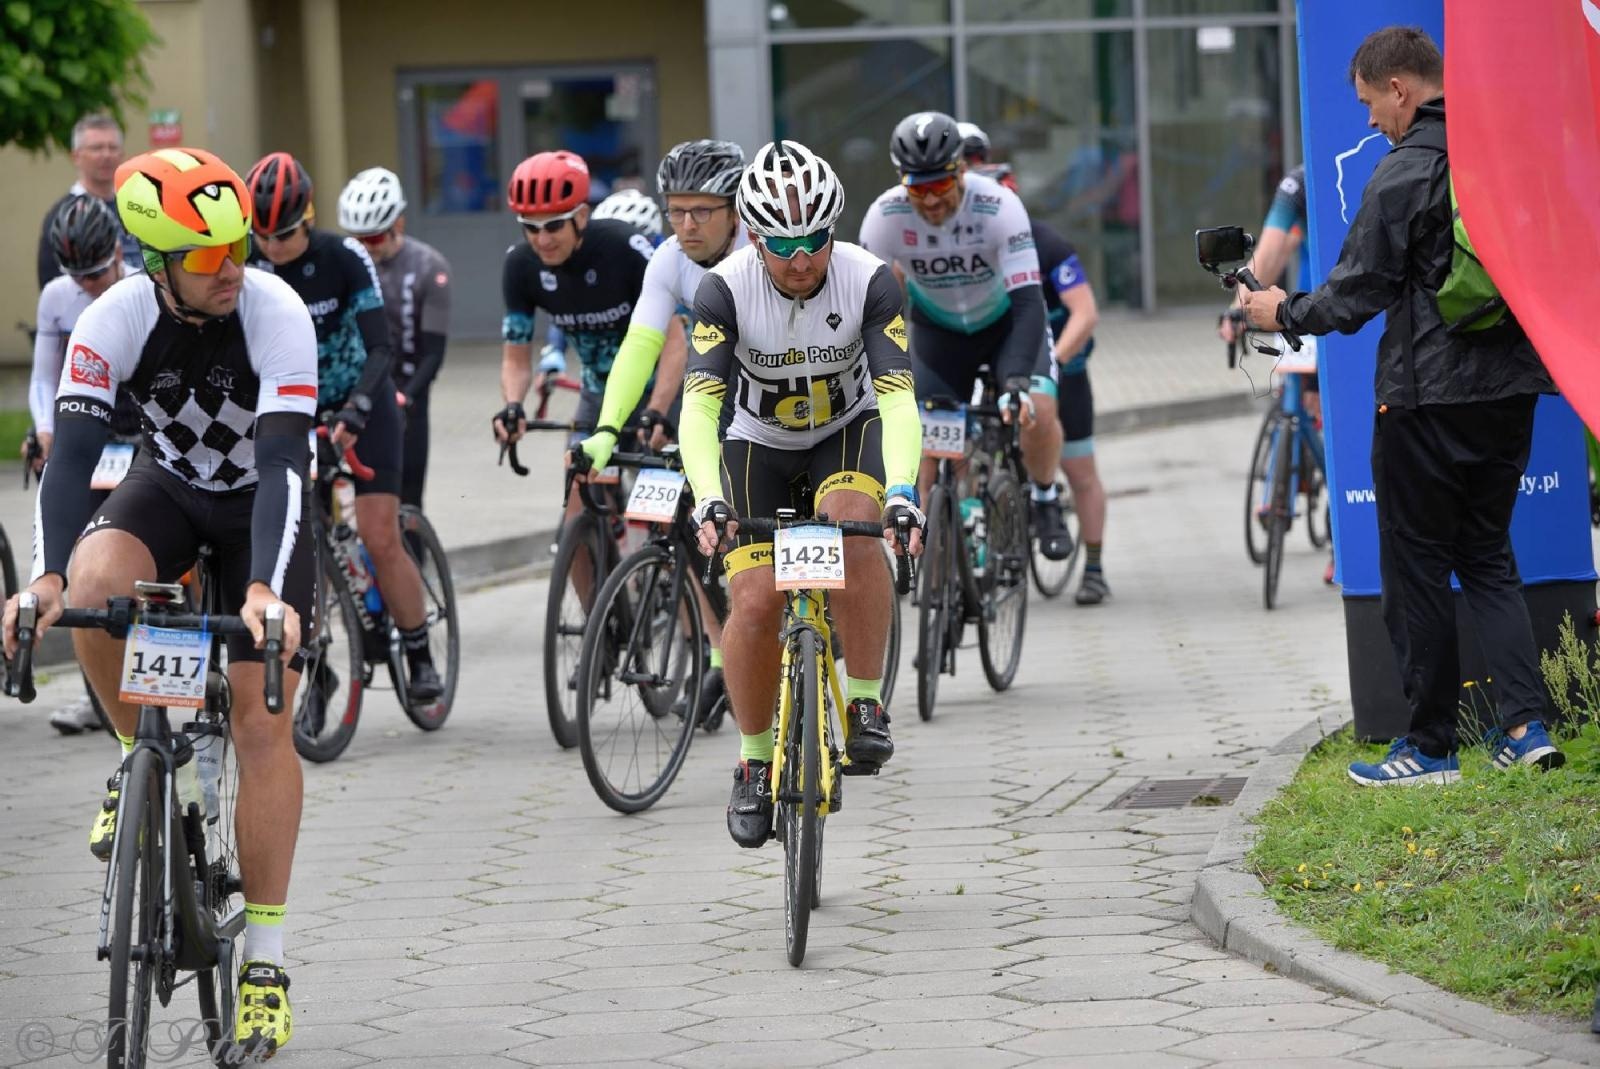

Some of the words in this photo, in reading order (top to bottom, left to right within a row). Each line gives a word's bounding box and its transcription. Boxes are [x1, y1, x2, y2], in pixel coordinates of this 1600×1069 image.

[911, 253, 989, 276] BORA
[308, 297, 339, 316] NDO
[576, 302, 632, 325] FONDO
[921, 424, 961, 442] 1433
[634, 484, 678, 502] 2250
[819, 474, 855, 495] quest
[780, 545, 841, 566] 1425
[131, 651, 207, 680] 1417
